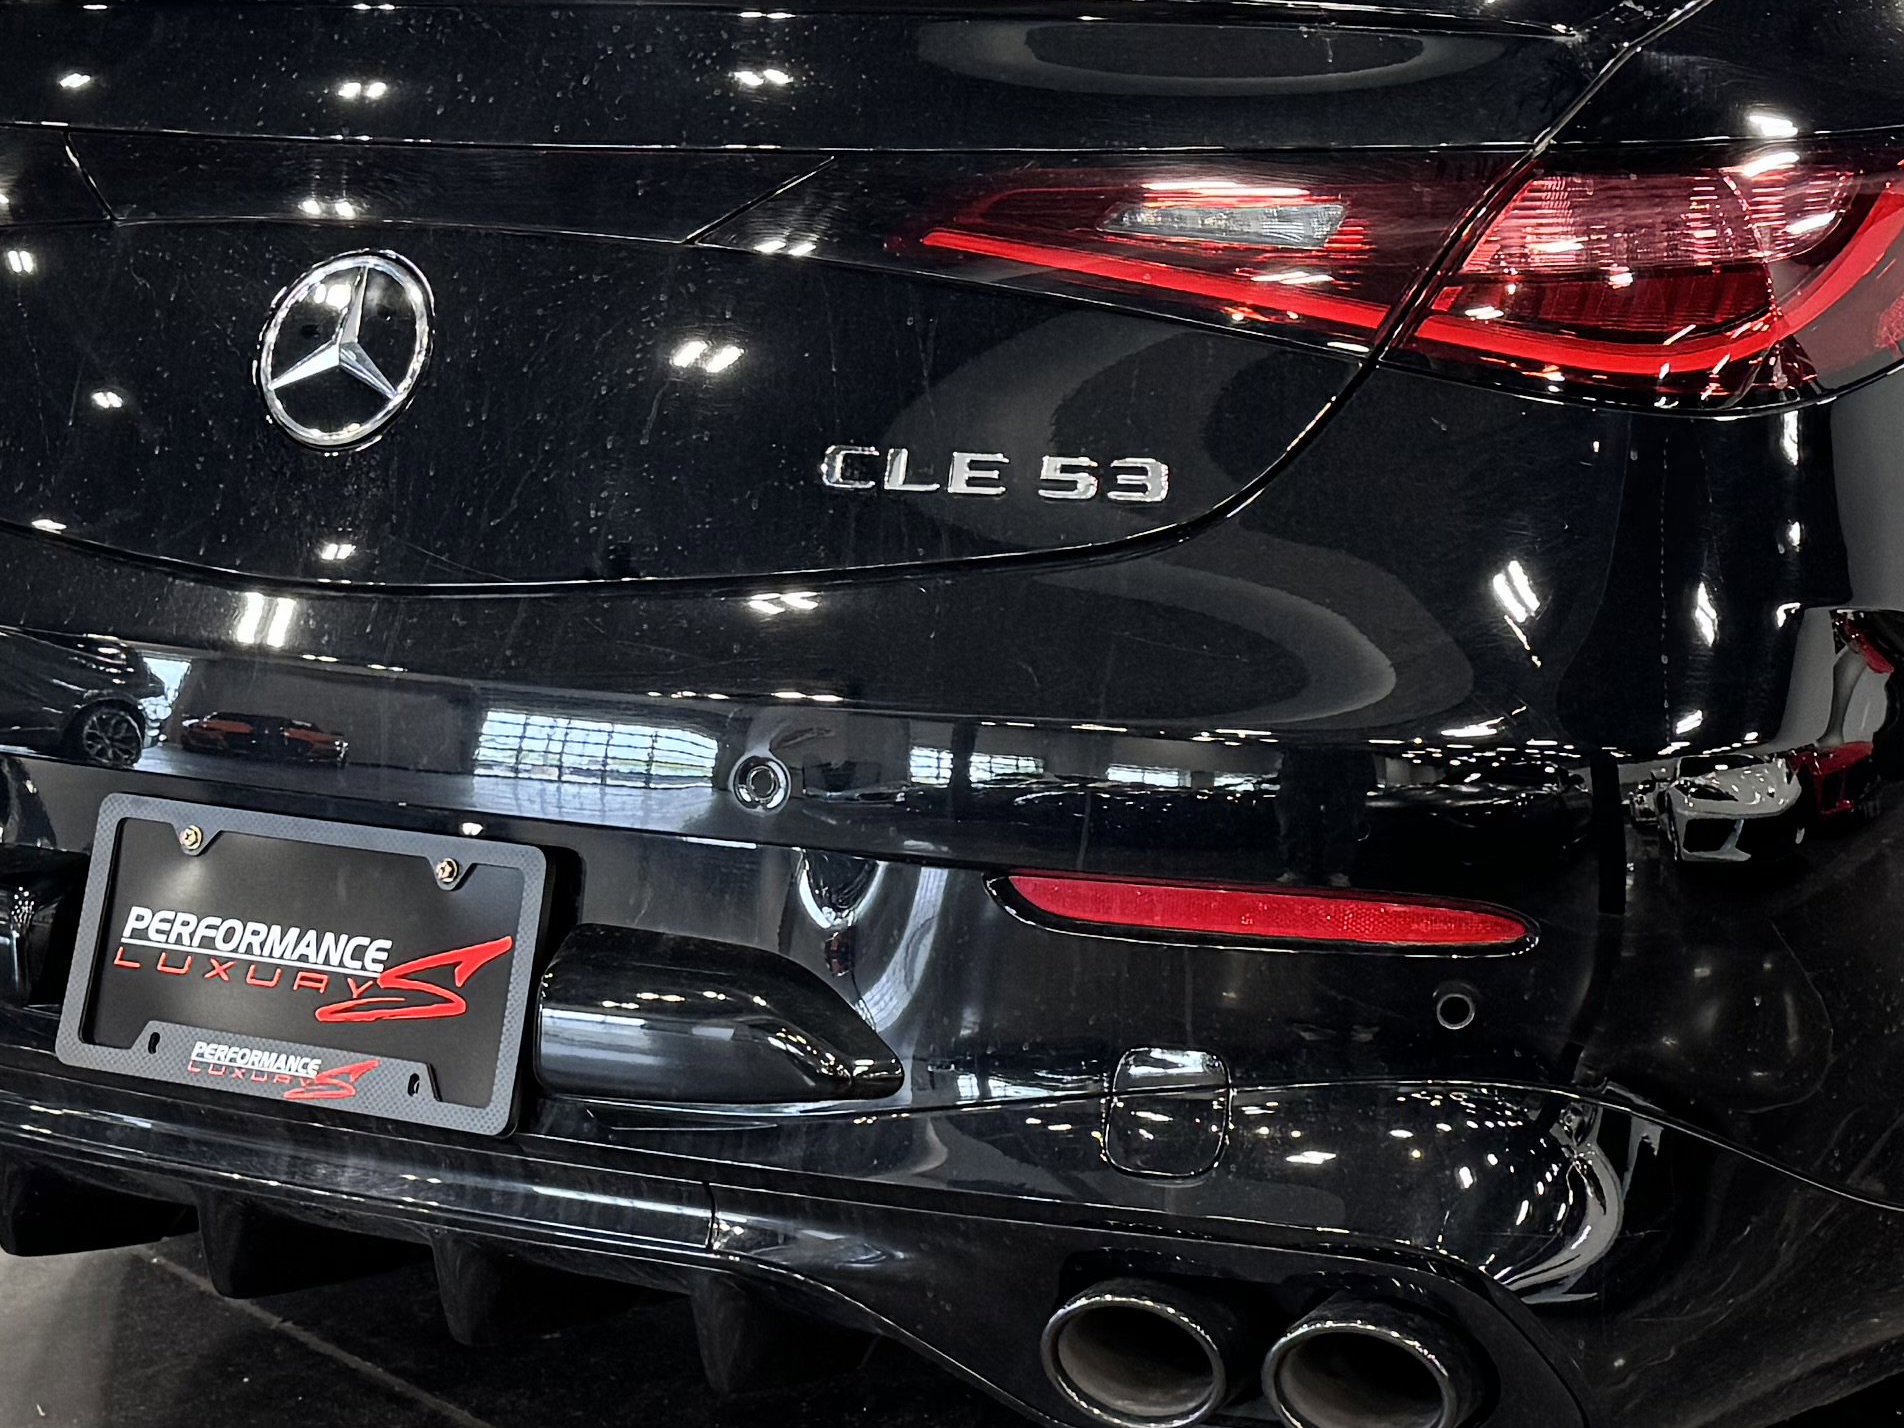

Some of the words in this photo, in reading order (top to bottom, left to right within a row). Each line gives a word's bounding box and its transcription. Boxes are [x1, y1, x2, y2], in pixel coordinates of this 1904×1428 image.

[821, 445, 1010, 495] CLE
[1038, 456, 1169, 502] 53
[122, 906, 393, 973] PERFORMANCE
[113, 946, 374, 998] LUXURY
[187, 1060, 312, 1087] LUXURY
[191, 1041, 323, 1075] PERFORMANCE
